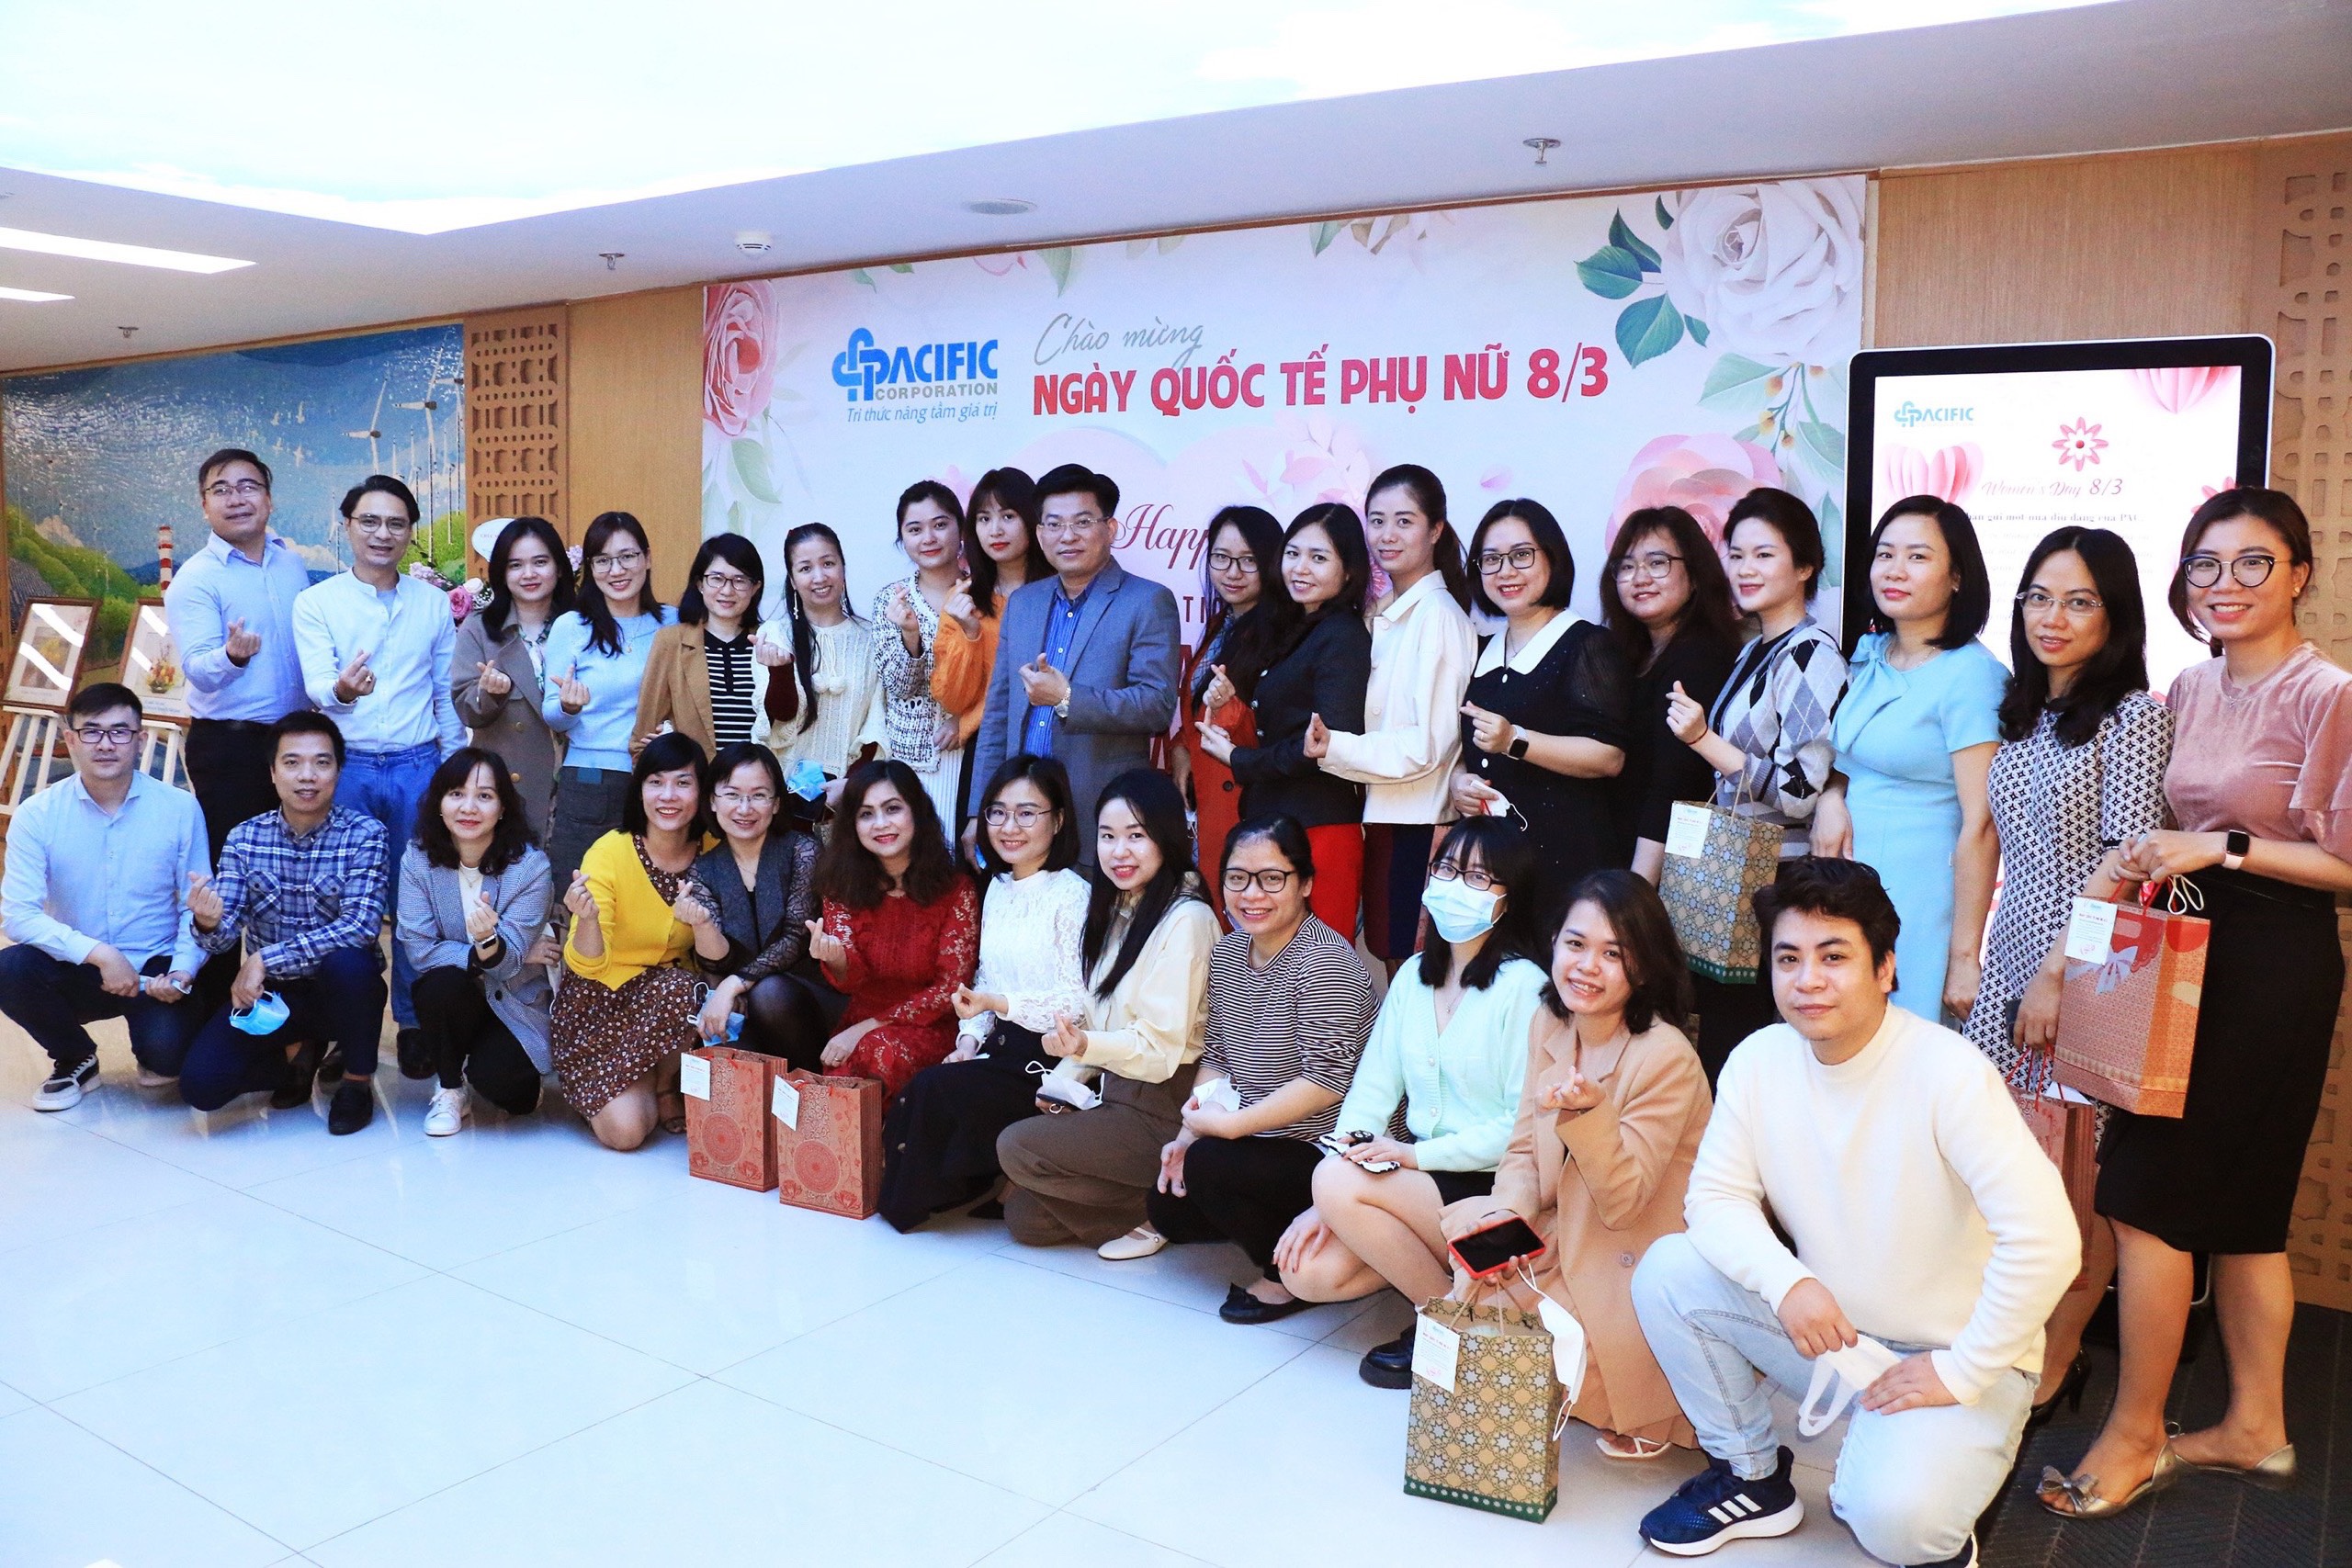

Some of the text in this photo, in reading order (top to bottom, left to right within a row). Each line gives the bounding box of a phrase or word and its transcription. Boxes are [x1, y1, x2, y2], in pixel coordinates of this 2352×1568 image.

[1034, 312, 1204, 371] Chào mừng
[860, 339, 999, 401] PACIFIC
[1033, 342, 1609, 417] NGÀY QUỐC TẾ PHỤ NỮ 8/3
[865, 404, 891, 422] thức
[894, 404, 928, 423] nâng
[930, 400, 956, 420] tầm
[957, 402, 980, 423] giá
[983, 401, 999, 421] trị
[875, 382, 999, 401] CORPORATION
[1906, 407, 1974, 427] PACIFIC
[2050, 481, 2082, 498] Day
[2089, 478, 2123, 496] 8/3
[1110, 503, 1210, 570] Happ
